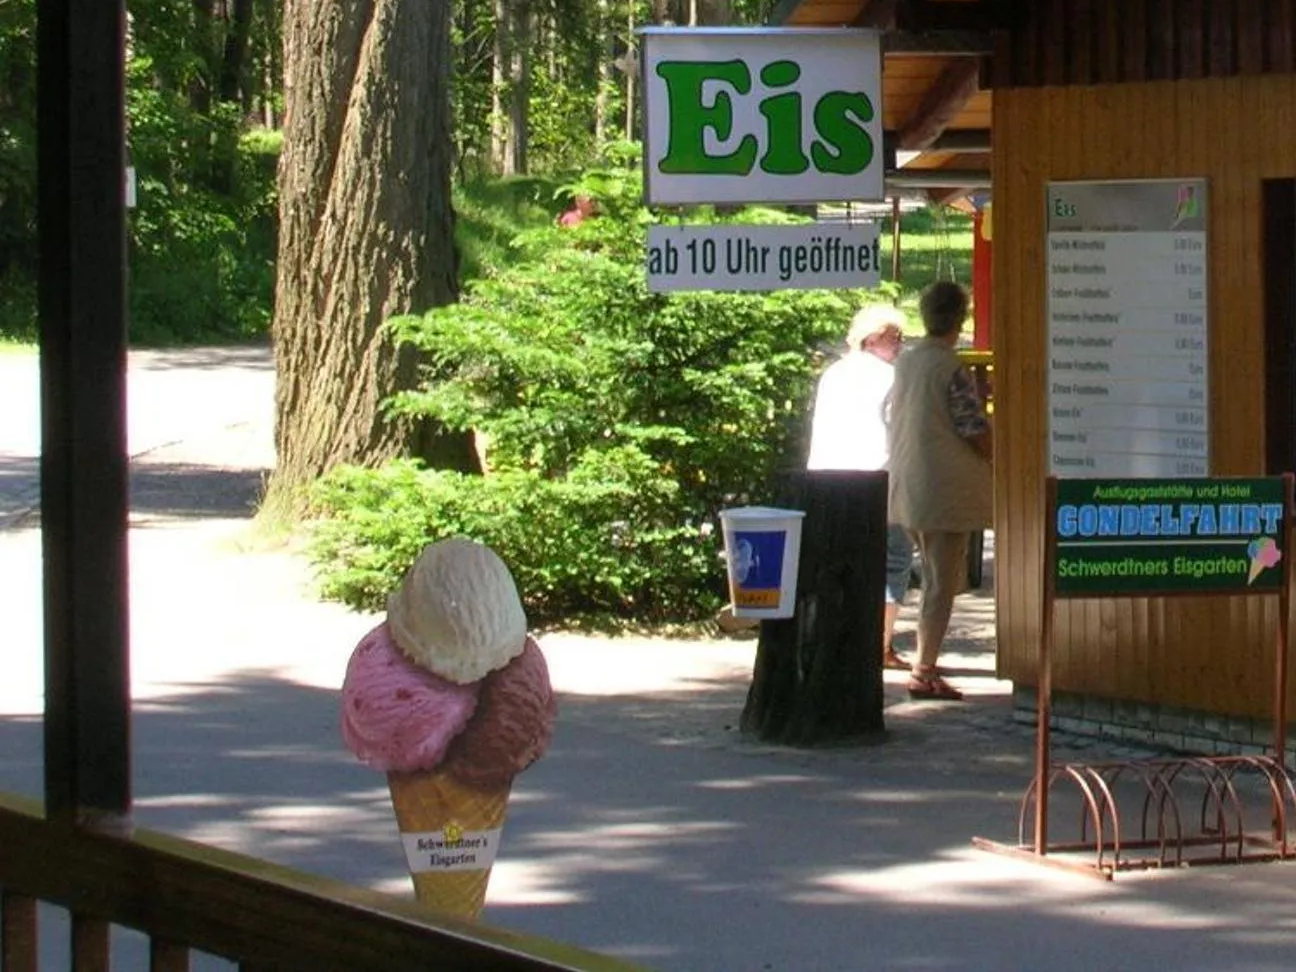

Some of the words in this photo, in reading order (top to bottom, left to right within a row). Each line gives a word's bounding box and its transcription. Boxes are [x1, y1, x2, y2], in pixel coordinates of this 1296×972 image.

[656, 59, 874, 176] Eis
[650, 239, 678, 274] ab
[687, 239, 716, 274] 10
[726, 239, 769, 274] Uhr
[779, 238, 880, 281] geöffnet
[1057, 503, 1283, 537] GONDELFAHRT
[1058, 558, 1169, 577] Schwerdtners
[1174, 555, 1247, 578] Eisgarten
